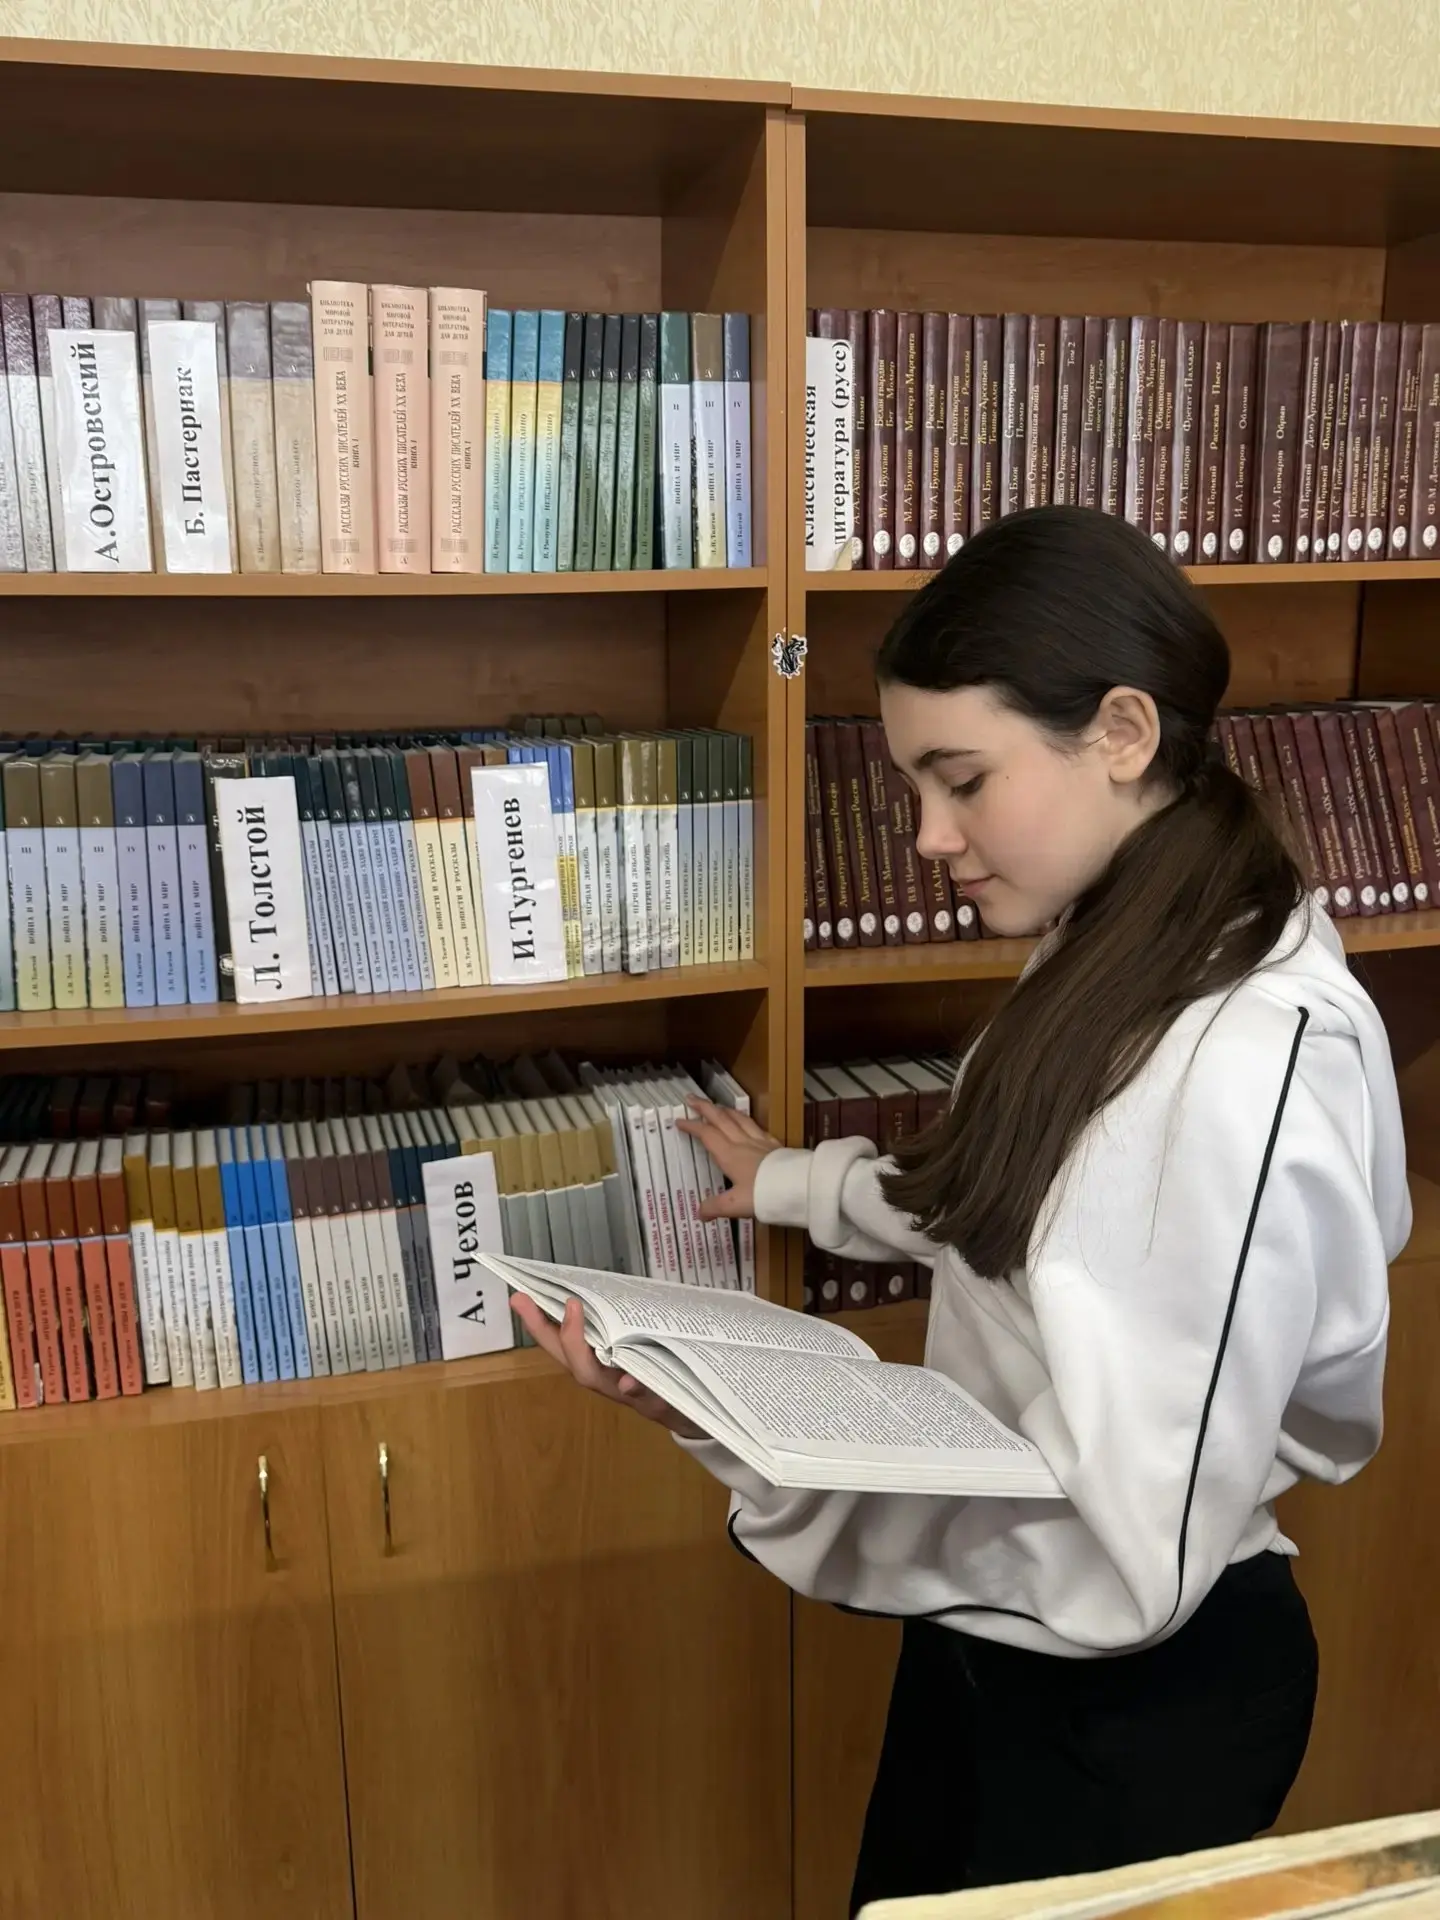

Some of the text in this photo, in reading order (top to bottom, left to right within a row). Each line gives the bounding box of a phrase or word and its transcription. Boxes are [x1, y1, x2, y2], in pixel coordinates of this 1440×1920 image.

[336, 371, 346, 390] ВЕКА
[832, 342, 849, 408] (русс)
[906, 333, 916, 384] Маргарита
[397, 373, 406, 393] ВЕКА
[452, 374, 460, 394] ВЕКА
[905, 396, 915, 431] Мастер
[1210, 404, 1220, 450] Рассказы
[1239, 386, 1248, 429] Обломов
[70, 341, 119, 563] А.Островский
[176, 368, 205, 535] Б. Пастернак
[334, 409, 349, 454] ПИСАТЕЛЕЙ
[394, 410, 407, 454] ПИСАТЕЛЕЙ
[449, 411, 460, 455] ПИСАТЕЛЕЙ
[338, 457, 350, 491] РУССКИХ
[351, 445, 359, 468] КНИГА
[398, 458, 408, 491] РУССКИХ
[451, 459, 461, 492] РУССКИХ
[464, 447, 472, 470] КНИГА
[806, 385, 816, 547] Классическая
[1010, 467, 1019, 490] Блок
[1087, 458, 1096, 492] Гоголь
[1108, 458, 1118, 493] Гоголь
[1156, 446, 1167, 490] Гончаров
[1180, 446, 1191, 490] Гончаров
[1236, 444, 1246, 488] Гончаров
[1273, 450, 1284, 494] Гончаров
[879, 445, 889, 518] М. А. Булгаков
[905, 449, 913, 521] М. А. Булгаков
[930, 447, 940, 519] М. А. Булгаков
[1207, 466, 1218, 505] Горький
[339, 493, 351, 533] РАССКАЗЫ
[399, 495, 408, 533] РАССКАЗЫ
[451, 495, 462, 533] РАССКАЗЫ
[1207, 506, 1215, 521] М.
[237, 806, 282, 990] Л. Толстой
[503, 798, 536, 961] И.Тургенев
[453, 1182, 486, 1326] А. Чехов
